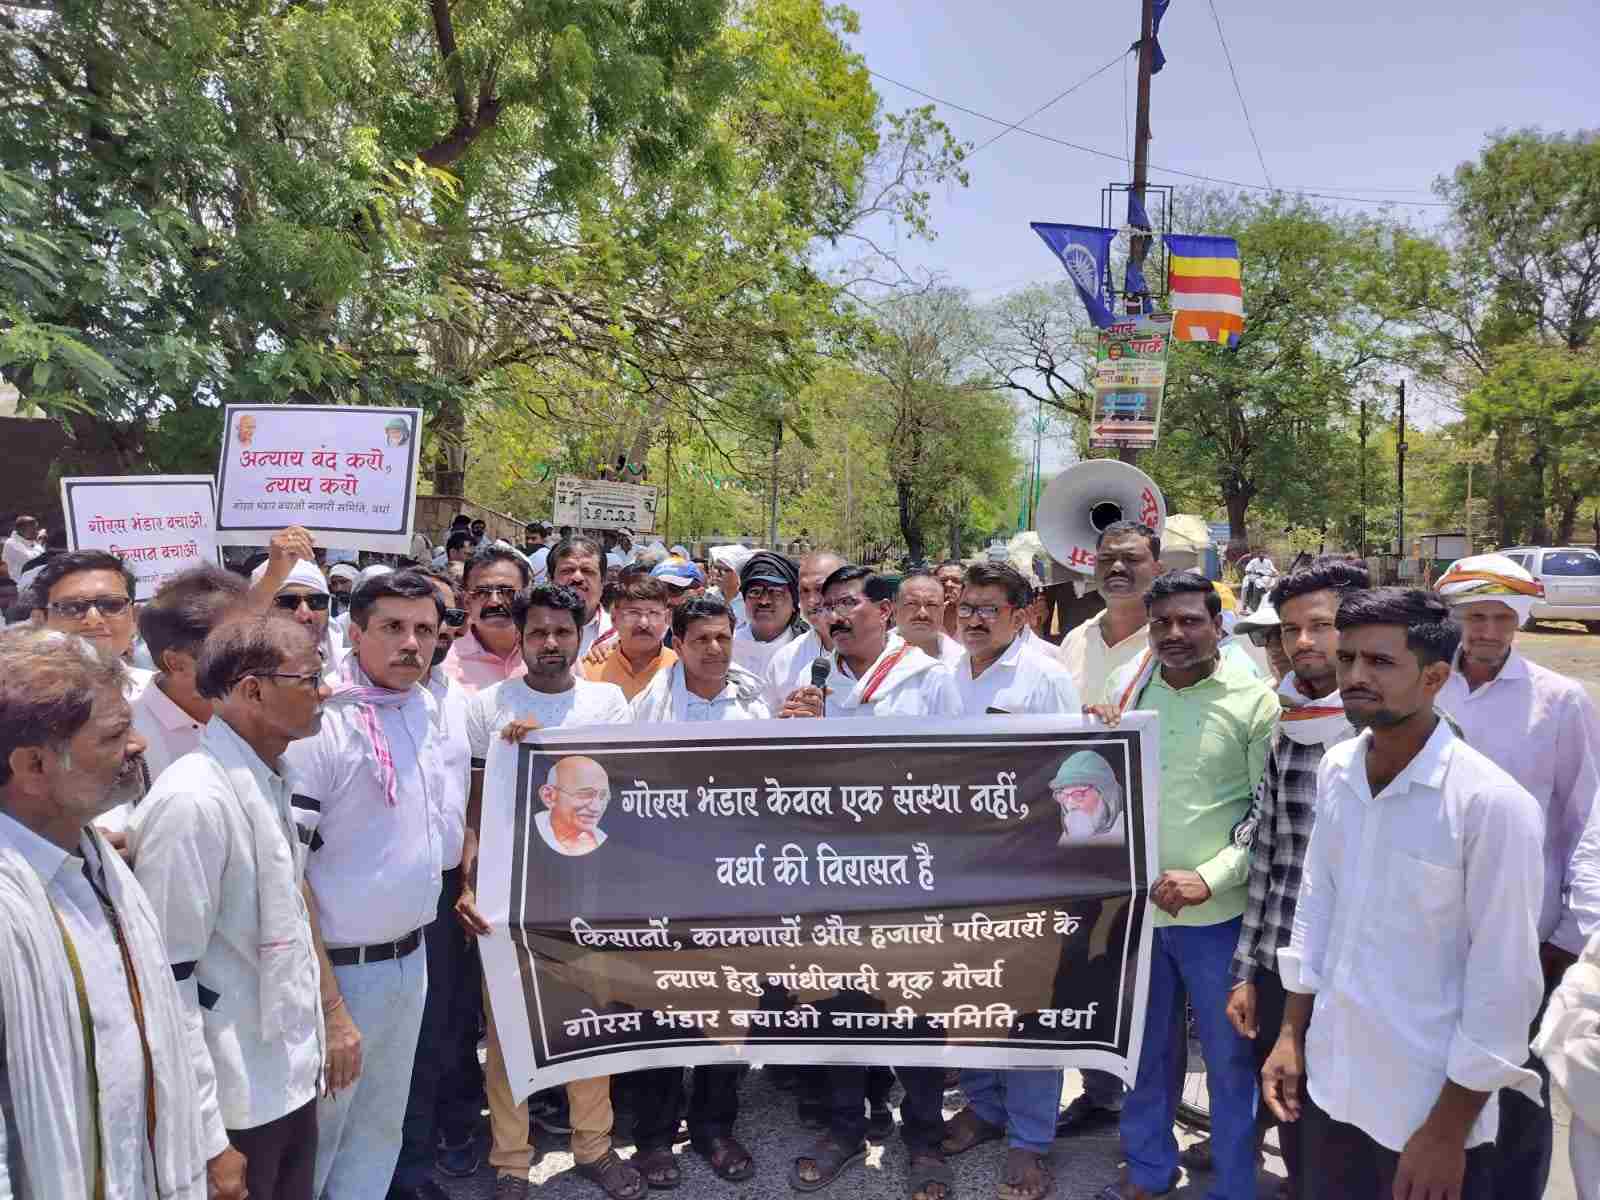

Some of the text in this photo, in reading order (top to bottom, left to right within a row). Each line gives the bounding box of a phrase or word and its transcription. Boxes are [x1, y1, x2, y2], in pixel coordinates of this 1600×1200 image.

[239, 444, 392, 474] अन्याय बंद करो,
[265, 473, 359, 495] न्याय करो
[87, 515, 127, 535] गोरस
[130, 513, 164, 532] भंडार
[159, 540, 200, 561] बचाओ
[620, 771, 1030, 823] गोरस भंडार केवल एक संस्था नहीं,
[715, 842, 935, 891] वर्धा की विरासत है
[569, 910, 1082, 952] किसानों, कामगारों और हजारों परिवारों के
[653, 959, 1005, 1000] न्याय हेतु गांधीवादी मूक मोर्चा
[563, 1001, 1099, 1039] गोरस भंडार बचाओ नागरी समिति, वर्धा
